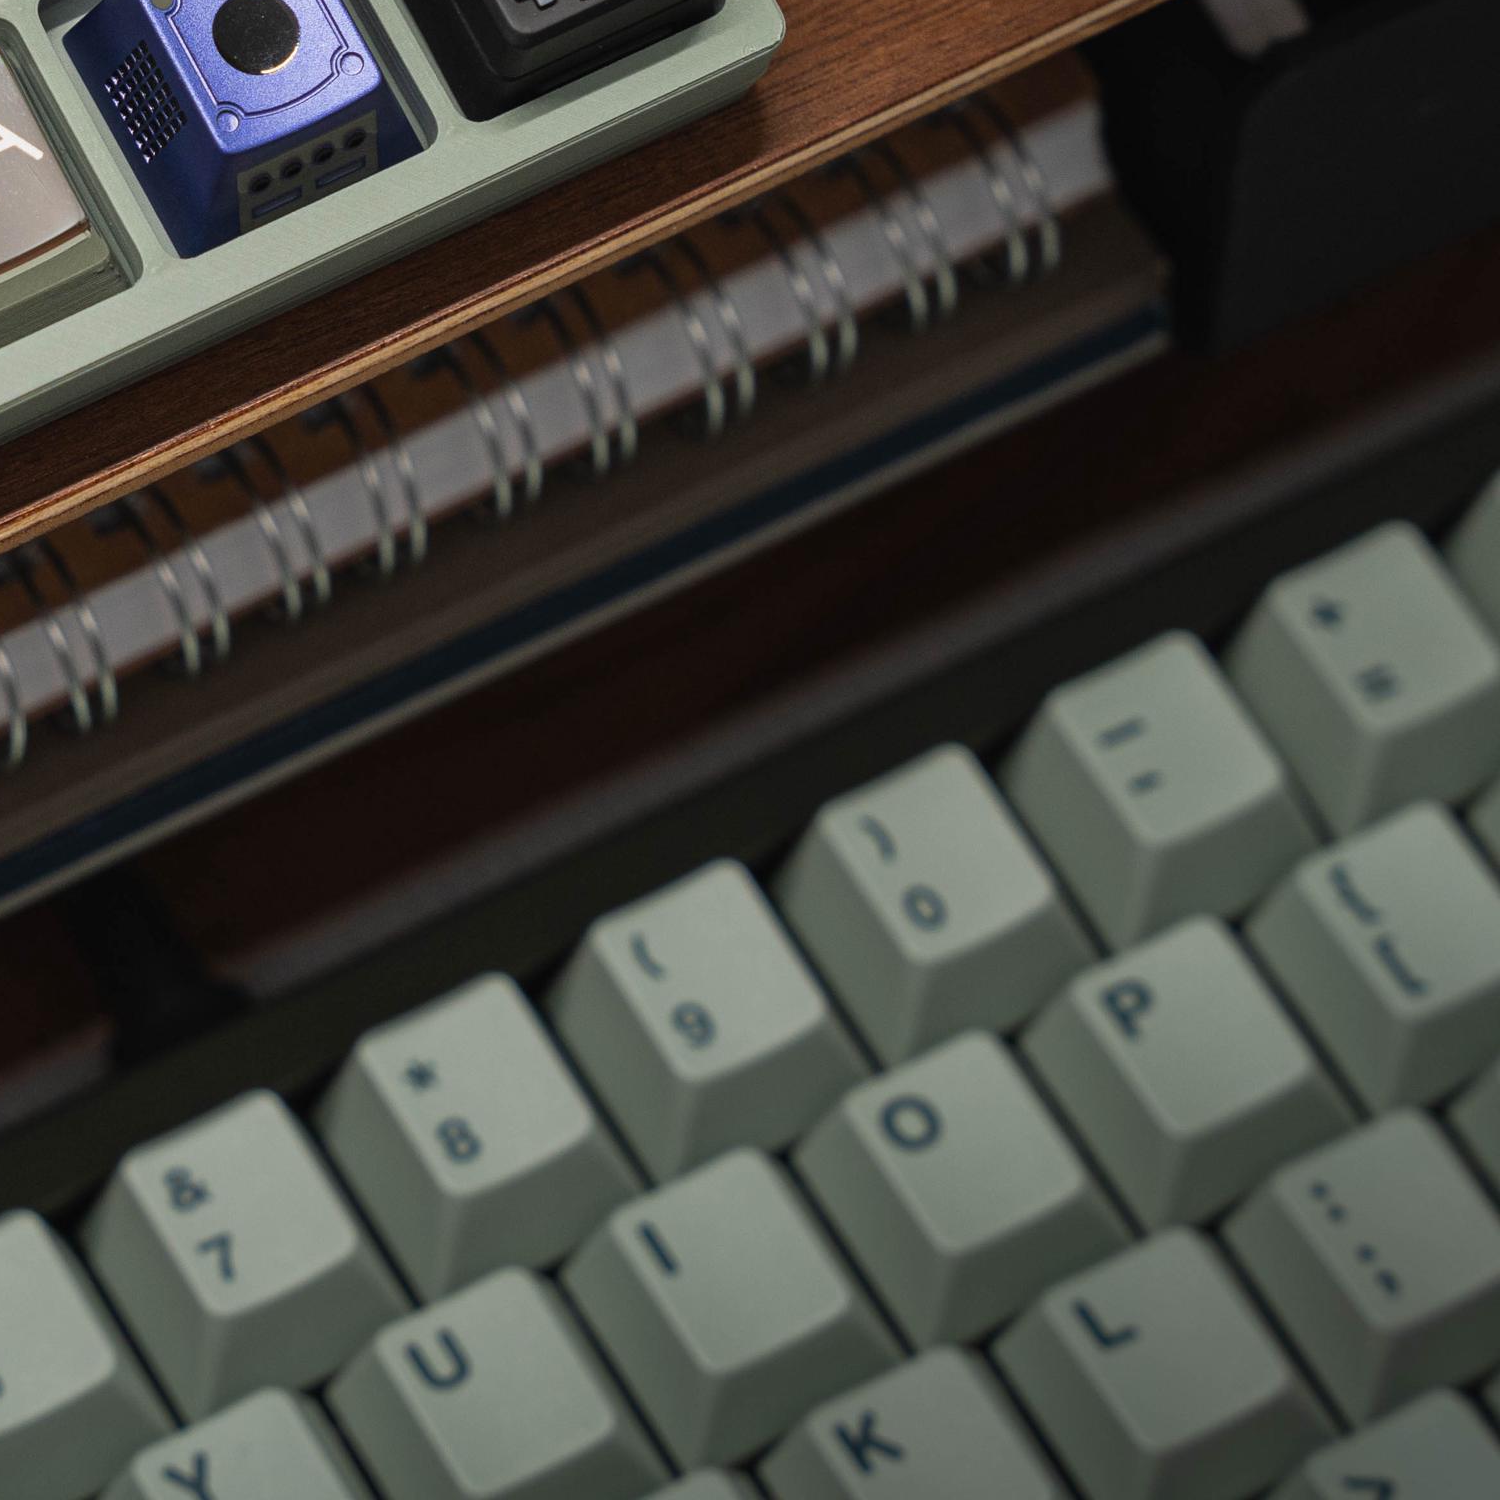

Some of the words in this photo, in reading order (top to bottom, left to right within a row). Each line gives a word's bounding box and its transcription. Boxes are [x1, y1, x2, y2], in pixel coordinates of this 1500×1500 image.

[671, 1002, 716, 1049] 9
[1102, 978, 1155, 1042] P
[435, 1118, 482, 1165] 8
[879, 1096, 942, 1153] O
[163, 1167, 214, 1214] &
[196, 1232, 236, 1283] 7
[1073, 1301, 1139, 1351] L
[405, 1327, 471, 1392] U
[834, 1413, 903, 1474] K
